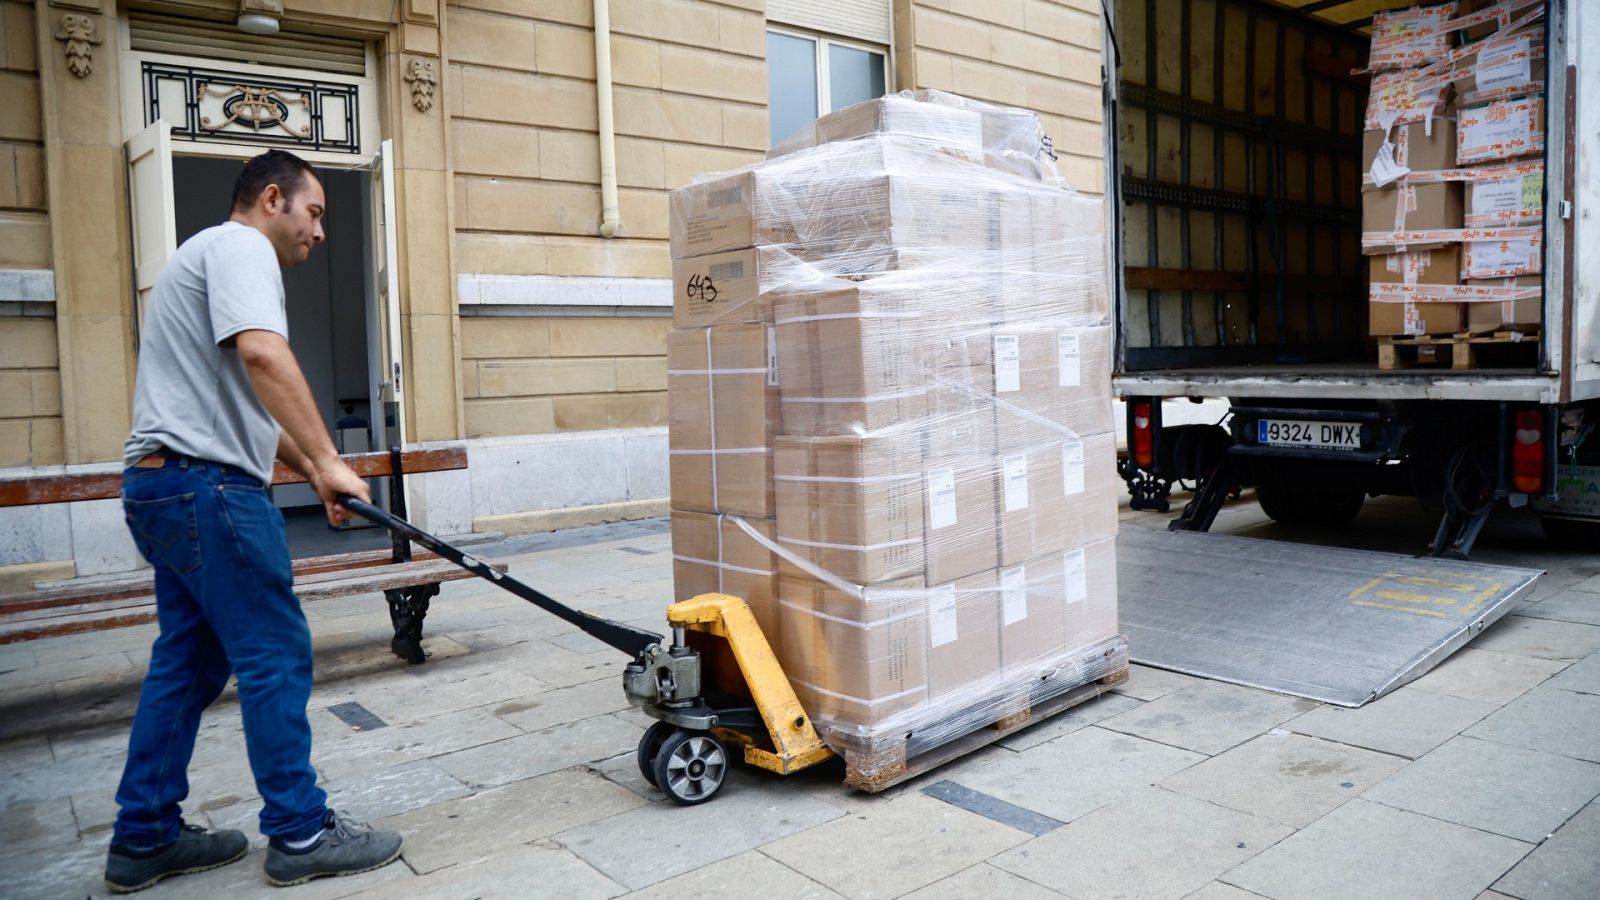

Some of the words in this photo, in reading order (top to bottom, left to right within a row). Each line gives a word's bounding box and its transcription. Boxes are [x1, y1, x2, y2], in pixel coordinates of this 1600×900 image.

[687, 273, 717, 302] 643
[1269, 423, 1312, 442] 9324
[1321, 425, 1355, 444] DWX
